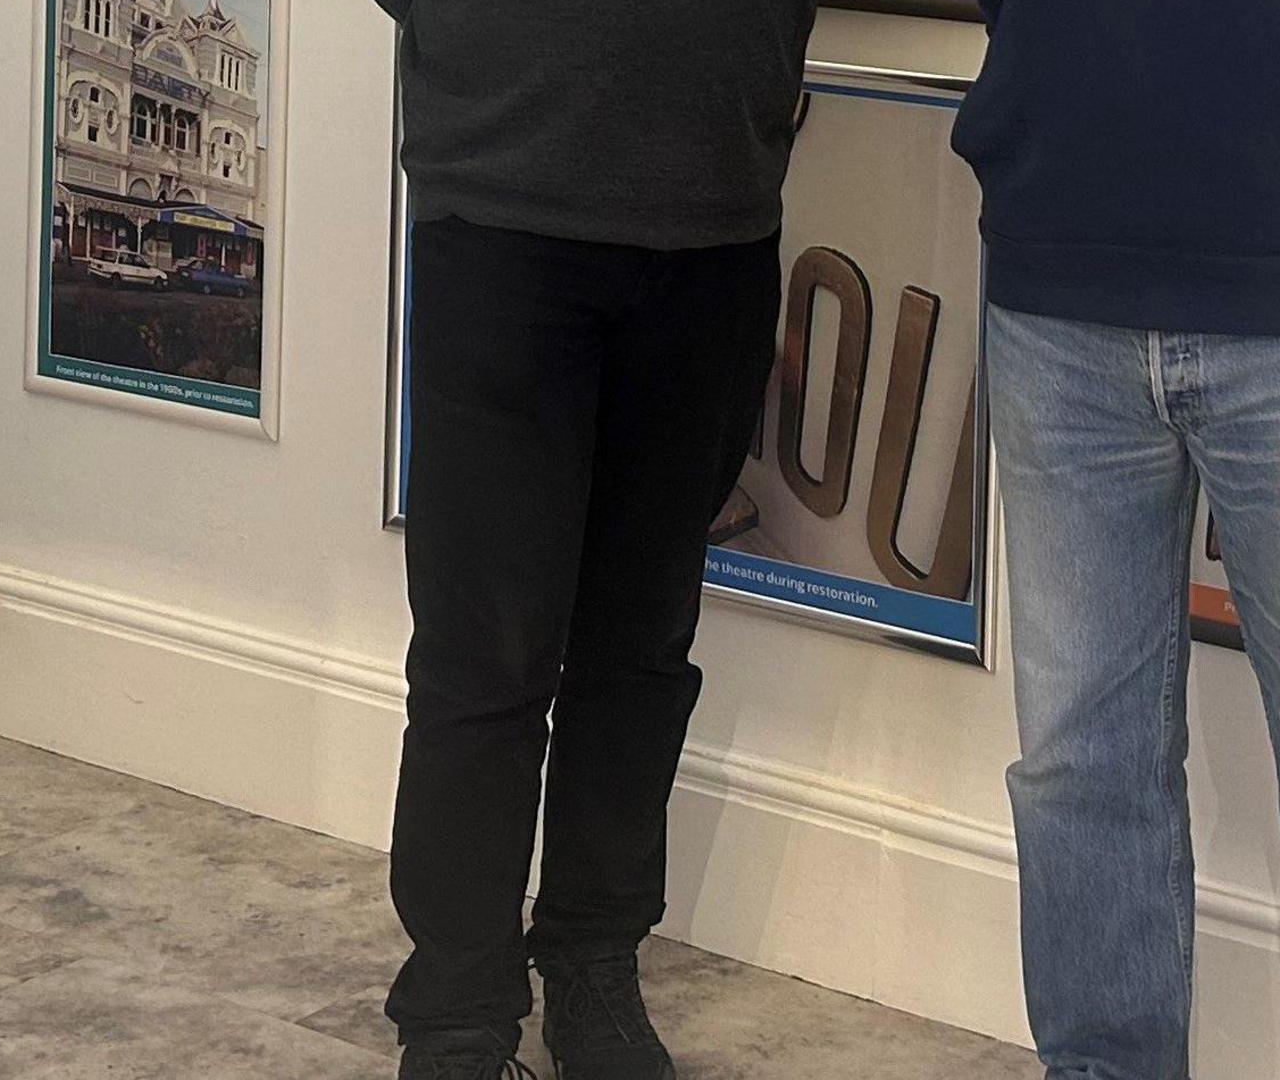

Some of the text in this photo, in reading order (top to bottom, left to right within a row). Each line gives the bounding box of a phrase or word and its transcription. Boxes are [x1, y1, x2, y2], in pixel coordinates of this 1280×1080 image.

[55, 365, 74, 376] Front
[705, 556, 879, 608] he theatre during restoration.
